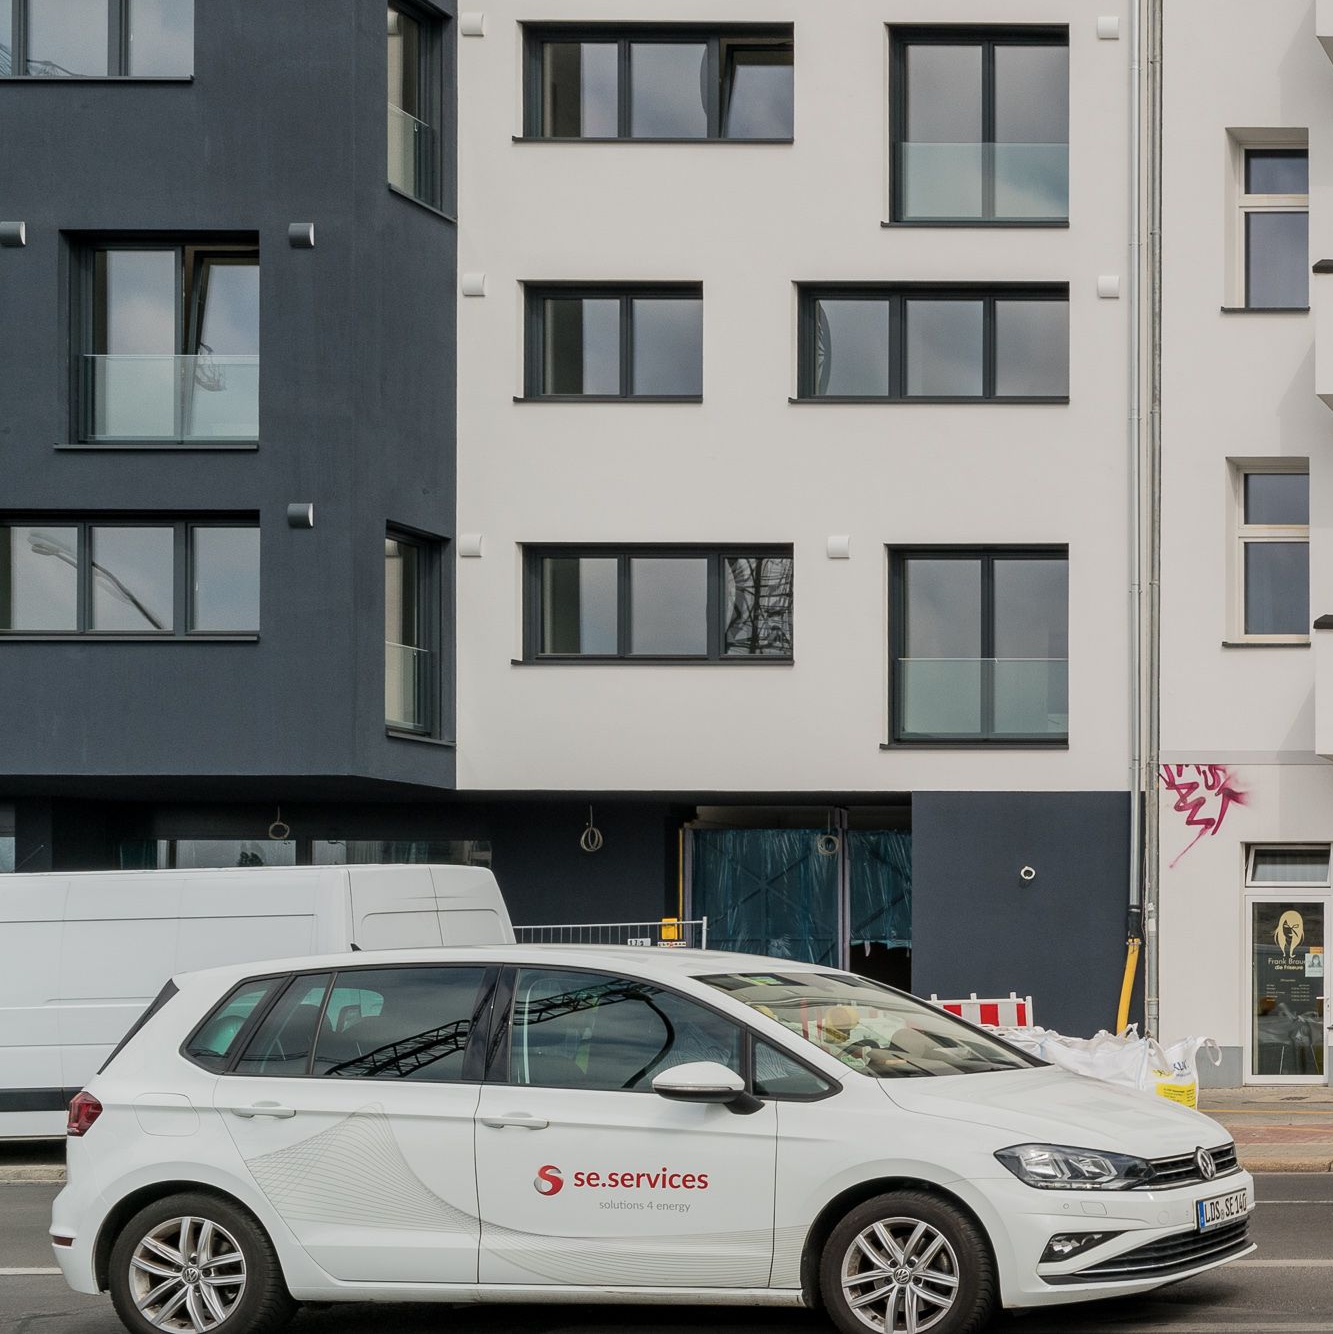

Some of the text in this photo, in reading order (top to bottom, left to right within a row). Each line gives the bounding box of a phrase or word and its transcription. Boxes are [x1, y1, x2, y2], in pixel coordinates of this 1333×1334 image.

[573, 1167, 709, 1190] se.services
[599, 1200, 691, 1213] solutions 4 energy
[1205, 1200, 1221, 1223] LDS
[1224, 1196, 1234, 1217] SE
